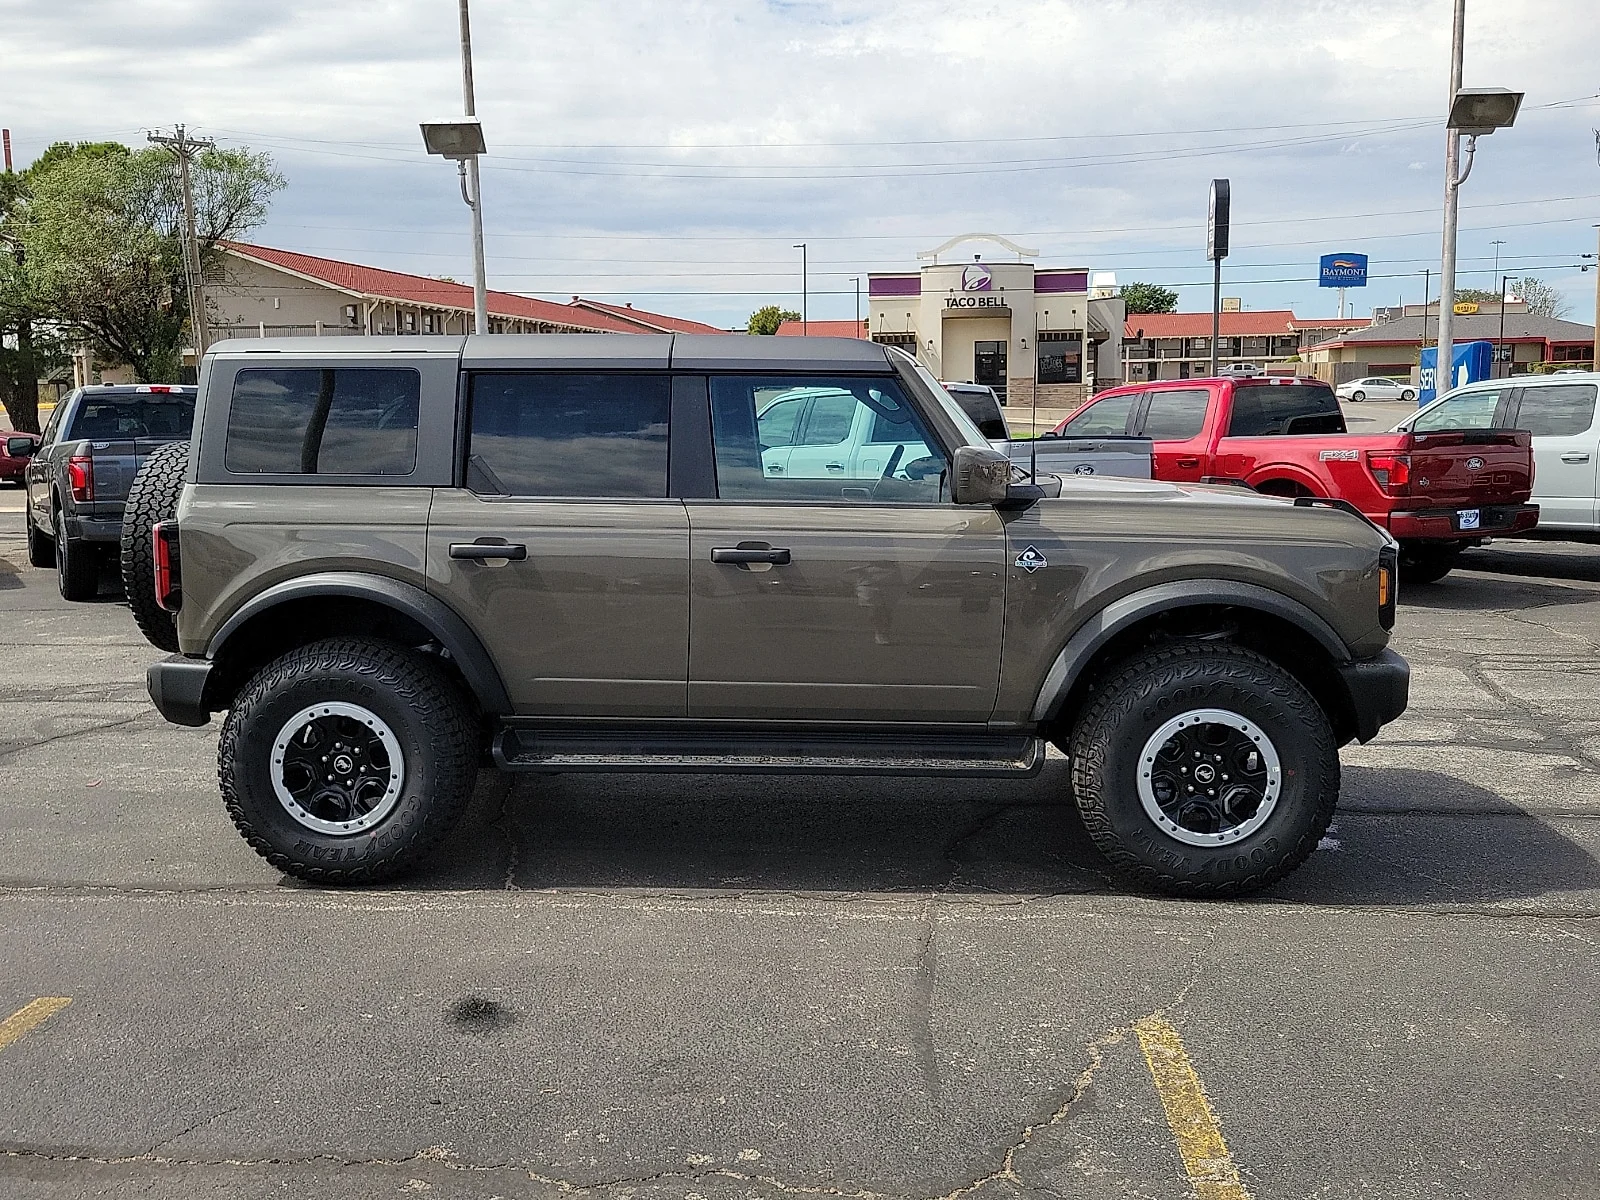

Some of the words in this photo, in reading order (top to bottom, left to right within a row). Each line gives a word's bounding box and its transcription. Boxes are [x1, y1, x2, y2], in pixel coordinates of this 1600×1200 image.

[1322, 267, 1366, 276] BAYMONT
[943, 297, 976, 308] TACO
[978, 296, 1008, 307] BELL
[1319, 450, 1359, 461] FX4
